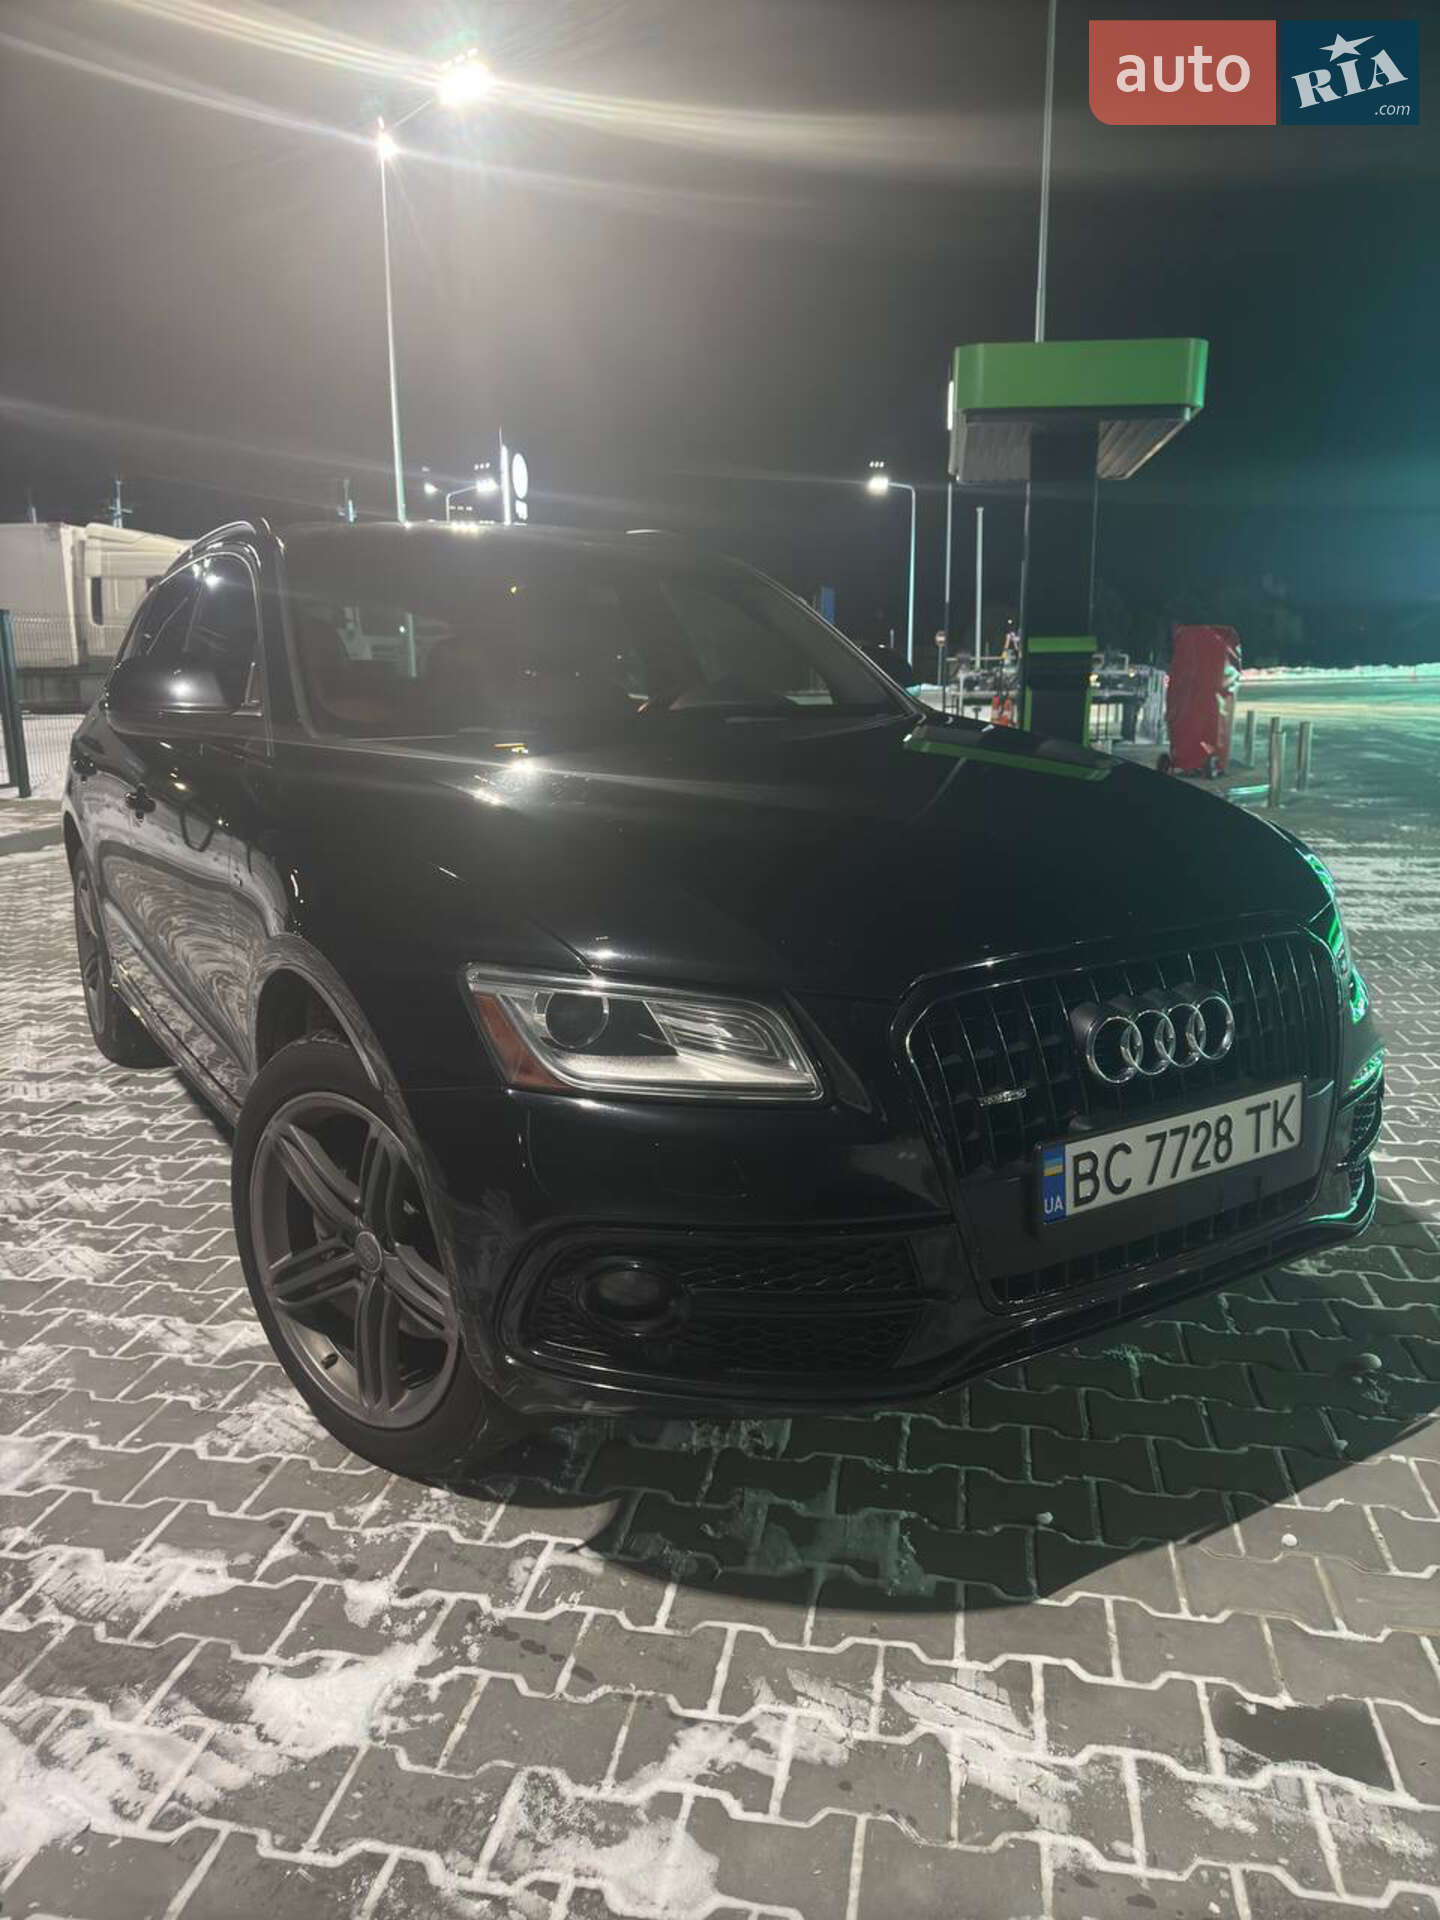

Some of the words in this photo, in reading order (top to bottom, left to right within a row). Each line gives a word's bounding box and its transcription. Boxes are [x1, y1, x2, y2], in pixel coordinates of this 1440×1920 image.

[1073, 1142, 1132, 1207] BC
[1145, 1114, 1233, 1186] 7728
[1245, 1094, 1296, 1154] TK
[1044, 1196, 1065, 1214] UA
